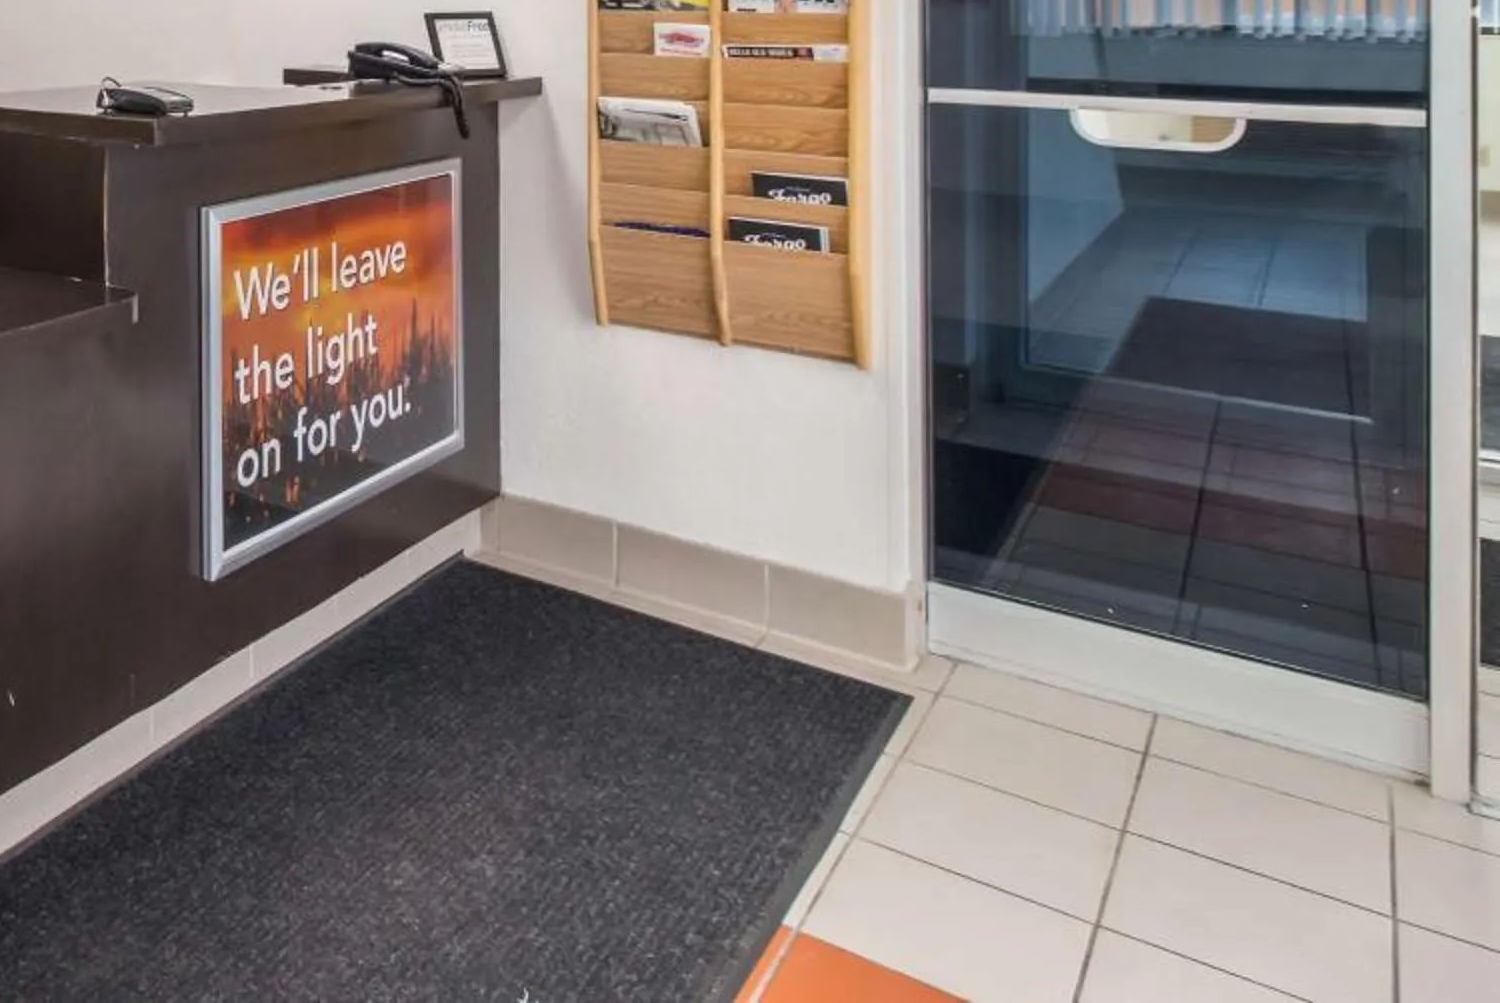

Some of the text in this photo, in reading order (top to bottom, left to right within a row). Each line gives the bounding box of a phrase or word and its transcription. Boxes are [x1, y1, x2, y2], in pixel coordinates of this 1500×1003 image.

[233, 241, 407, 322] We'll leave
[235, 312, 378, 405] the light
[236, 436, 282, 489] on
[293, 405, 341, 463] for
